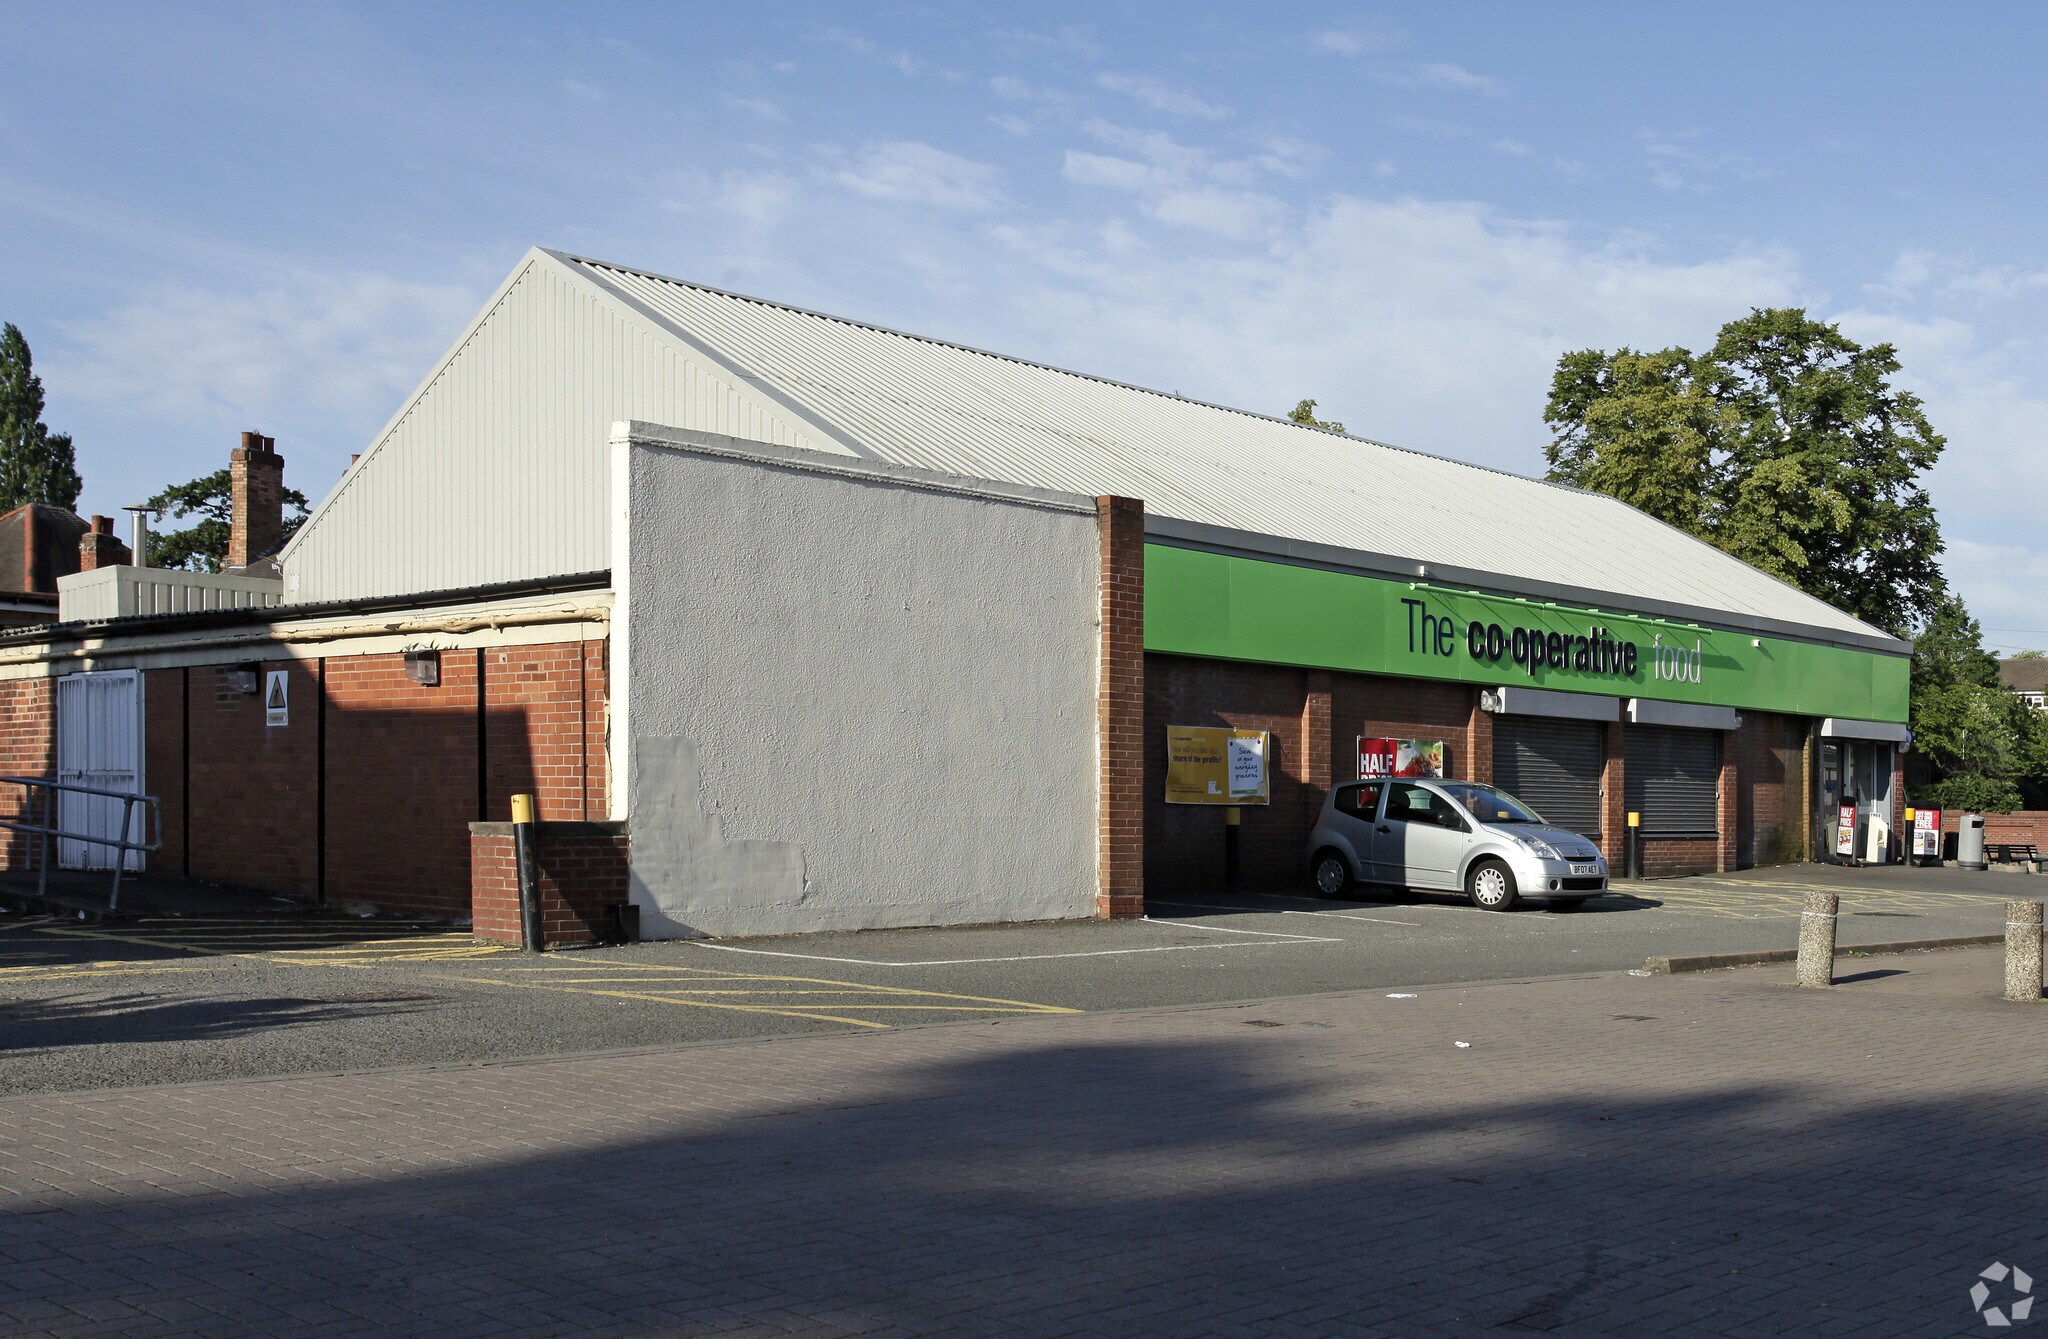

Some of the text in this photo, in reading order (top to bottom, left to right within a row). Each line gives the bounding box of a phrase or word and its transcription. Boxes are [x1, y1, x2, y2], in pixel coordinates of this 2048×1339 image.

[1401, 598, 1702, 684] The co-operative food
[1193, 755, 1201, 763] the
[1361, 753, 1393, 773] HALF
[1841, 808, 1853, 817] HALF
[1840, 818, 1852, 826] PRICE
[1915, 819, 1932, 829] FREE
